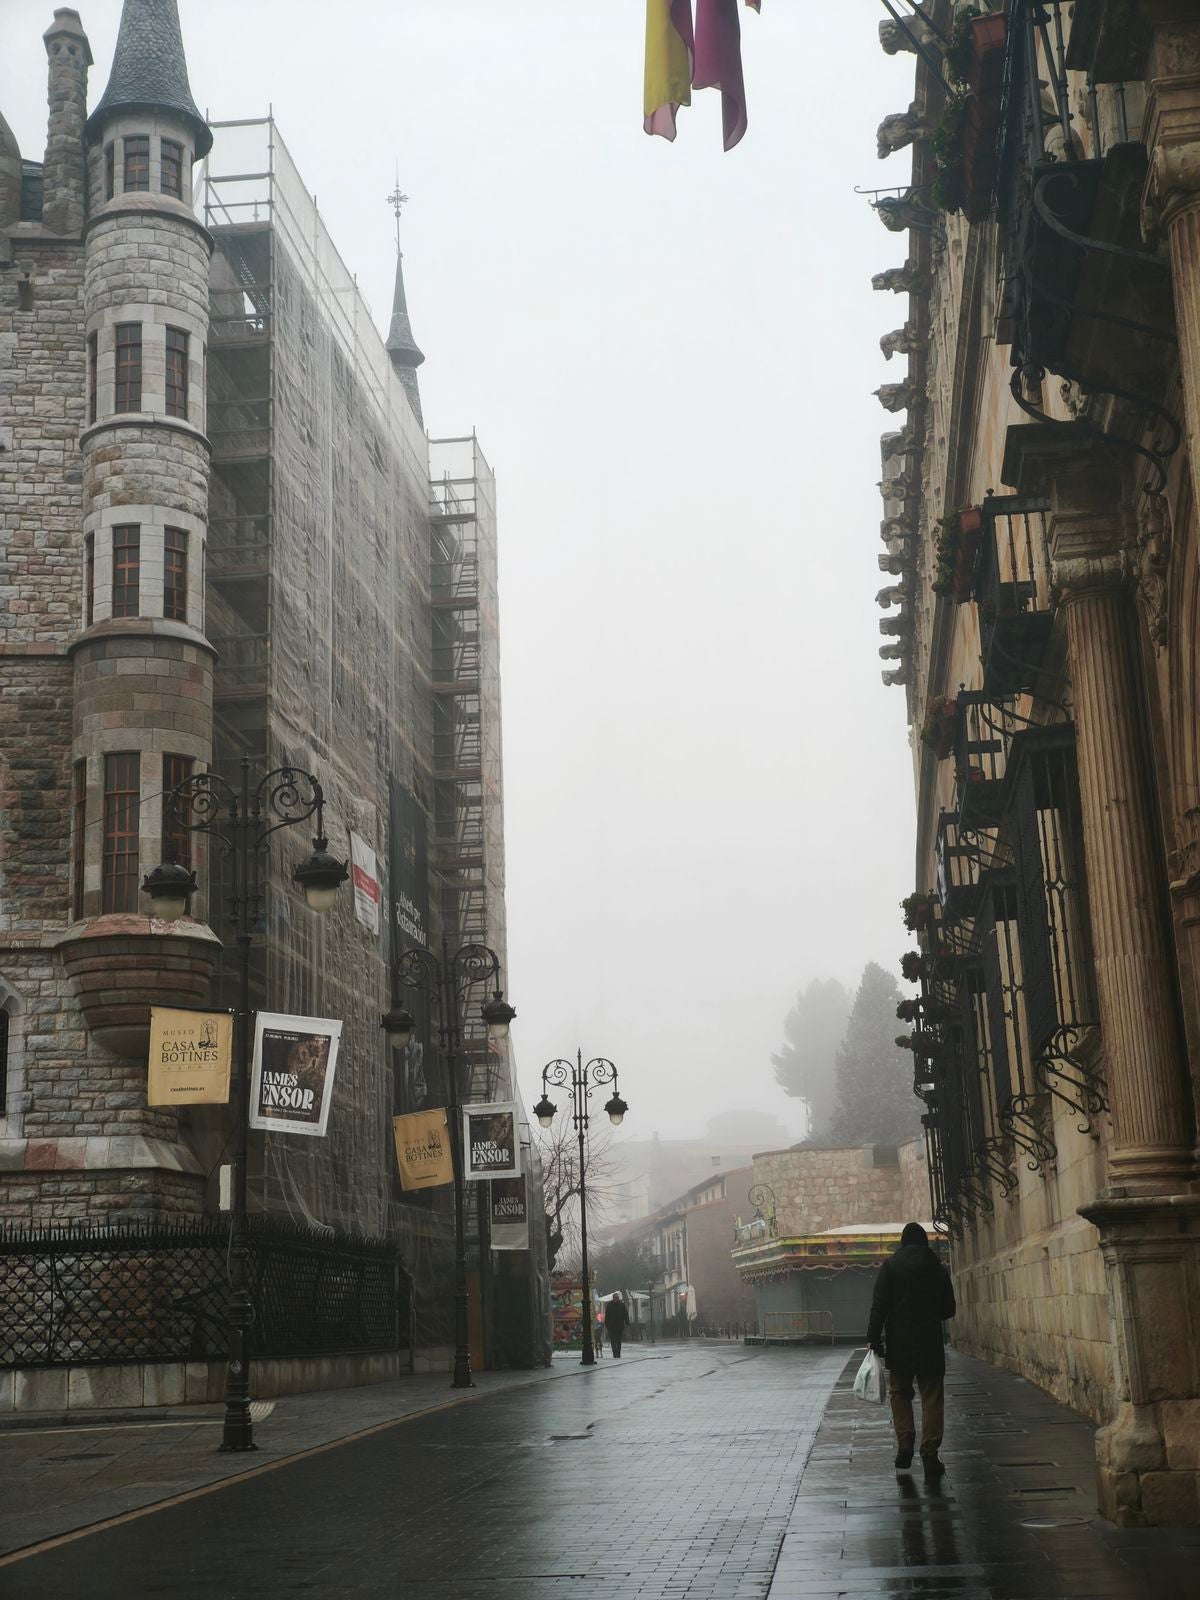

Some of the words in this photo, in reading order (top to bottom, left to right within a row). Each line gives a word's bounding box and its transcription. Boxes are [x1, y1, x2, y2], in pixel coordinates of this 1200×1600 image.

[162, 1041, 195, 1052] CASA
[161, 1051, 218, 1063] BOTINES
[263, 1071, 298, 1087] JAMES
[262, 1085, 314, 1110] ENSOR
[405, 1145, 427, 1155] CASA
[472, 1140, 497, 1151] JAMES
[405, 1149, 443, 1163] BOTINES
[472, 1148, 510, 1164] ENSOR
[499, 1197, 519, 1205] JAMES
[494, 1203, 524, 1216] ENSOR
